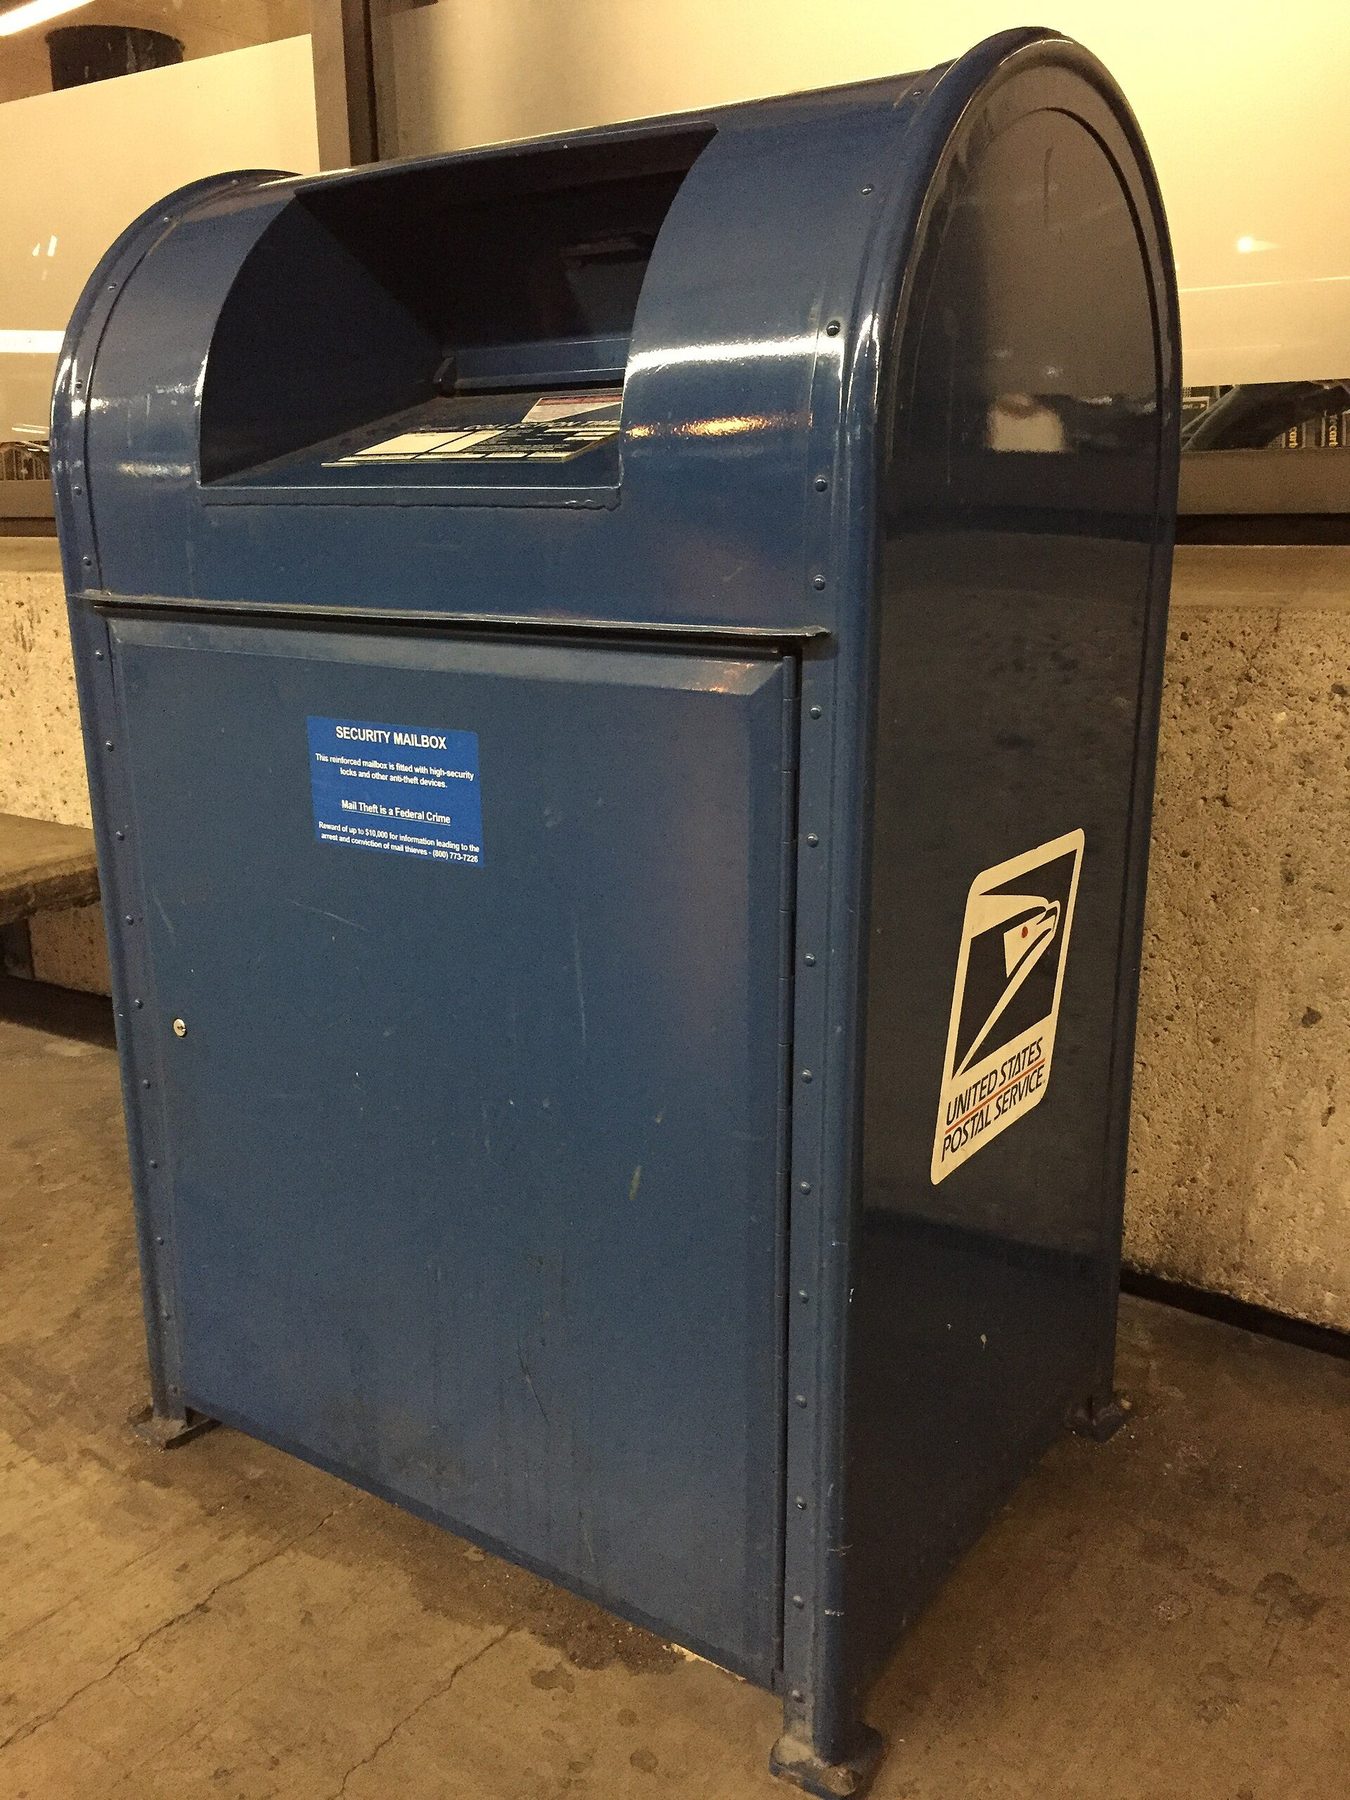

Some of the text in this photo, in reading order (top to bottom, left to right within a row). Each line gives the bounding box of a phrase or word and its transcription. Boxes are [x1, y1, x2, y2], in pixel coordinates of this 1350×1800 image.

[336, 726, 447, 749] SECURITY MAILBOX
[315, 753, 329, 762] This
[330, 756, 361, 766] reinforced
[362, 761, 388, 769] mailbox
[396, 763, 413, 773] fitted
[414, 766, 429, 774] with
[430, 767, 474, 781] high-security
[340, 767, 357, 777] locks
[371, 772, 389, 781] other
[390, 775, 419, 784] anti-theft
[420, 777, 448, 788] devices.
[341, 800, 357, 810] Mail
[358, 802, 379, 813] Theft
[380, 805, 387, 814] is
[395, 807, 425, 820] Federal
[426, 812, 451, 824] Crime
[318, 821, 341, 831] Reward
[341, 825, 348, 833] of
[358, 827, 365, 835] to
[389, 832, 399, 840] for
[399, 834, 435, 846] information
[436, 840, 460, 852] leading
[461, 843, 469, 851] to
[469, 844, 480, 853] the
[321, 833, 339, 841] arrest
[339, 835, 351, 843] and
[351, 838, 382, 848] conviction
[383, 842, 391, 850] of
[391, 843, 405, 852] mail
[405, 845, 428, 856] thieves
[946, 1036, 1043, 1126] UNITED STATES
[941, 1064, 1045, 1163] POSTAL SERVICE
